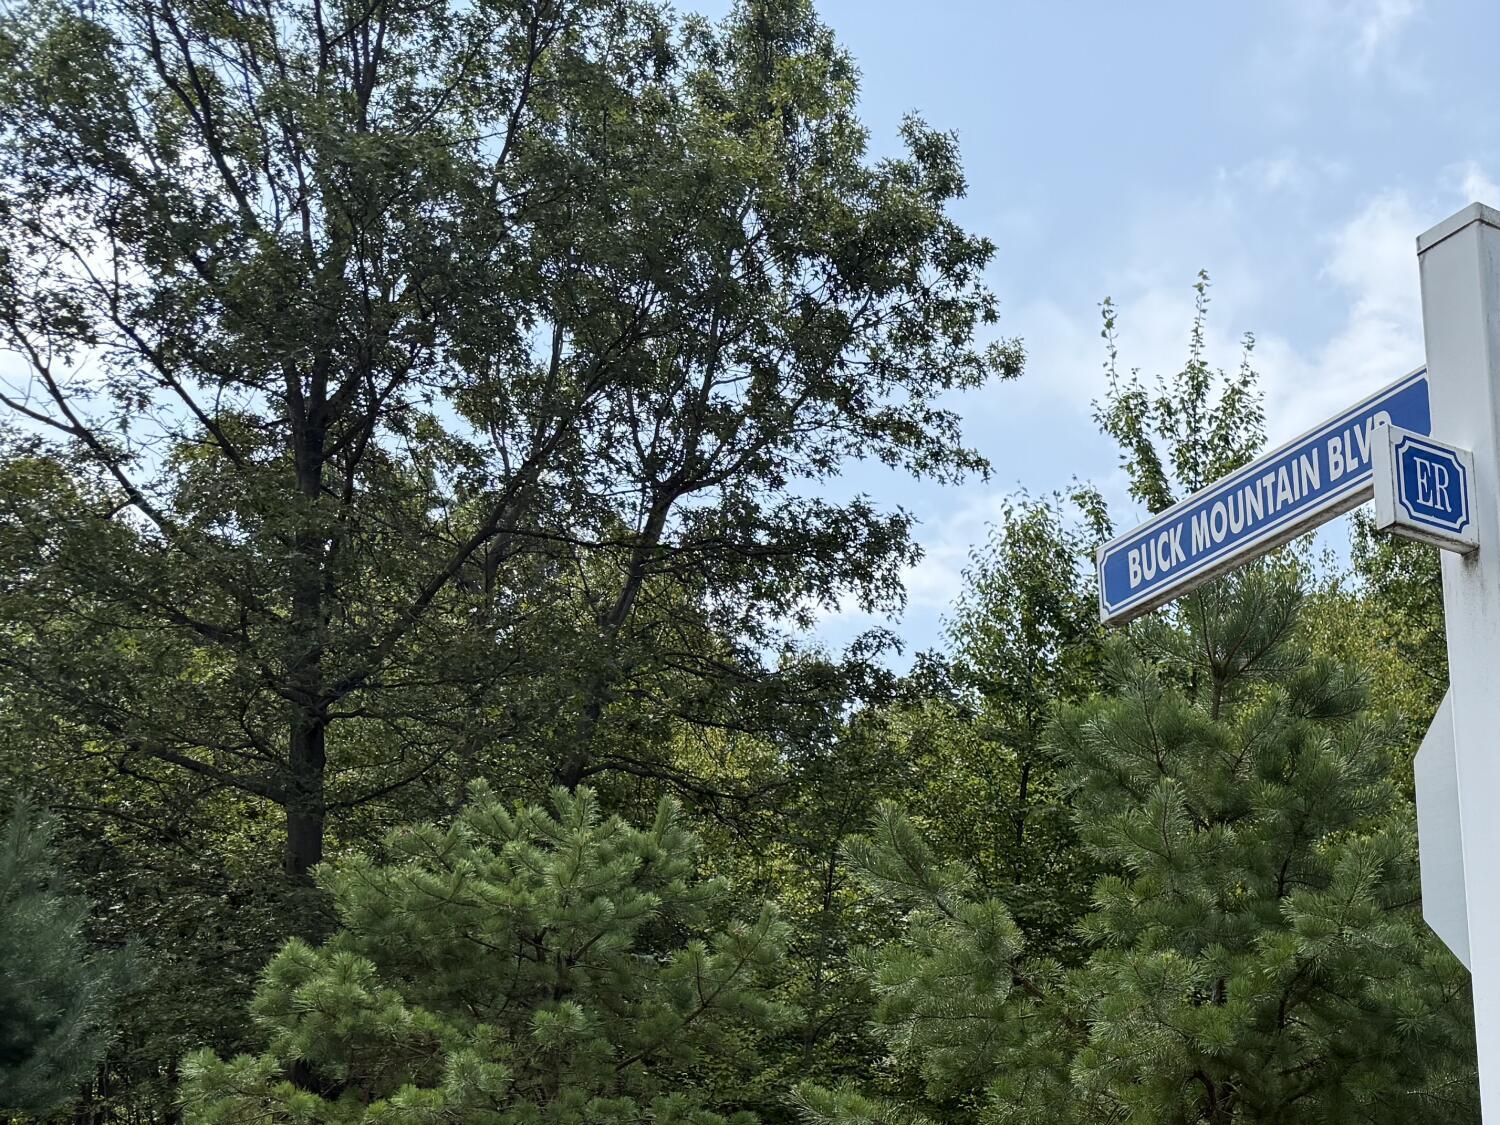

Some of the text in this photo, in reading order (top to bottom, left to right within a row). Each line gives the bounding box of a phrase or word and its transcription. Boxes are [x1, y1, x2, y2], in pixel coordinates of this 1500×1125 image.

[1128, 515, 1187, 589] BUCK
[1191, 447, 1321, 557] MOUNTAIN
[1413, 456, 1452, 513] ER
